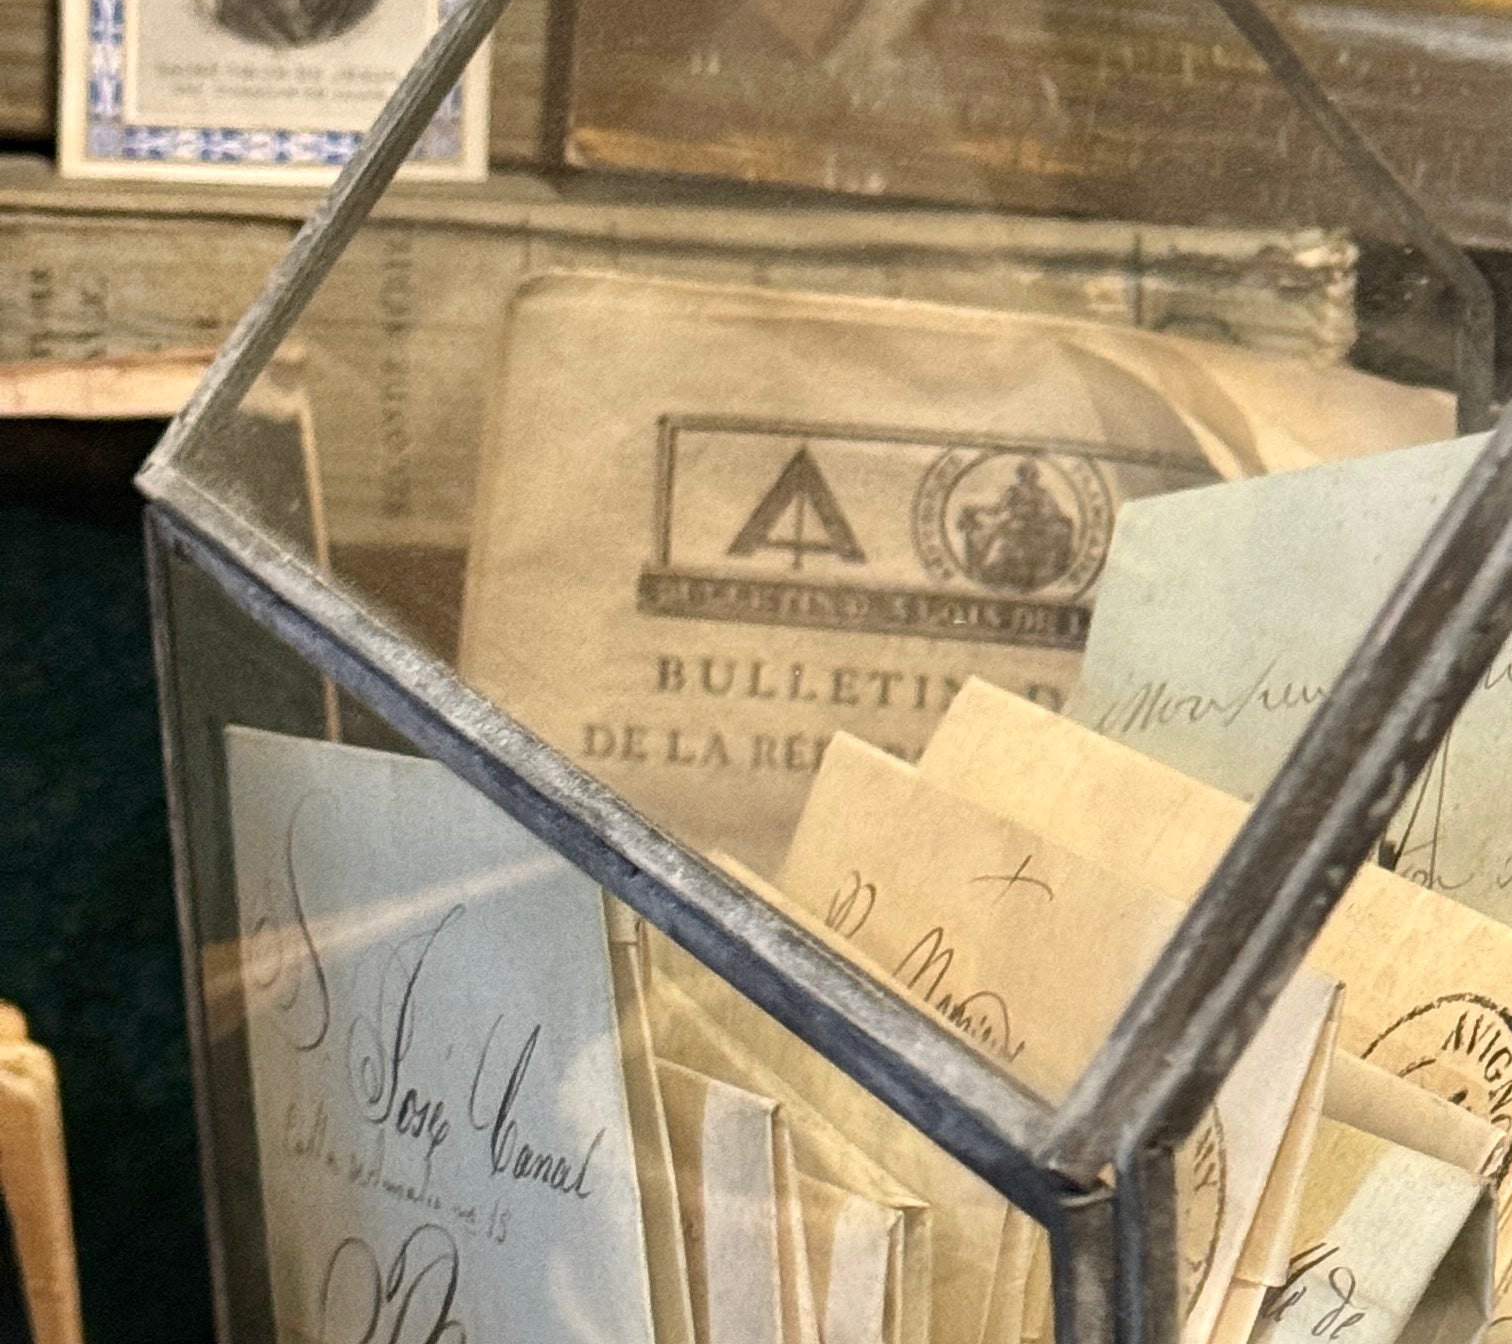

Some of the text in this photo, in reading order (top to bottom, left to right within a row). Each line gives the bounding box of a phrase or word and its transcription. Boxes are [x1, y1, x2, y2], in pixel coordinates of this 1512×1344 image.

[1100, 656, 1332, 735] Monsieu
[582, 722, 650, 760] DE
[665, 727, 730, 769] LA
